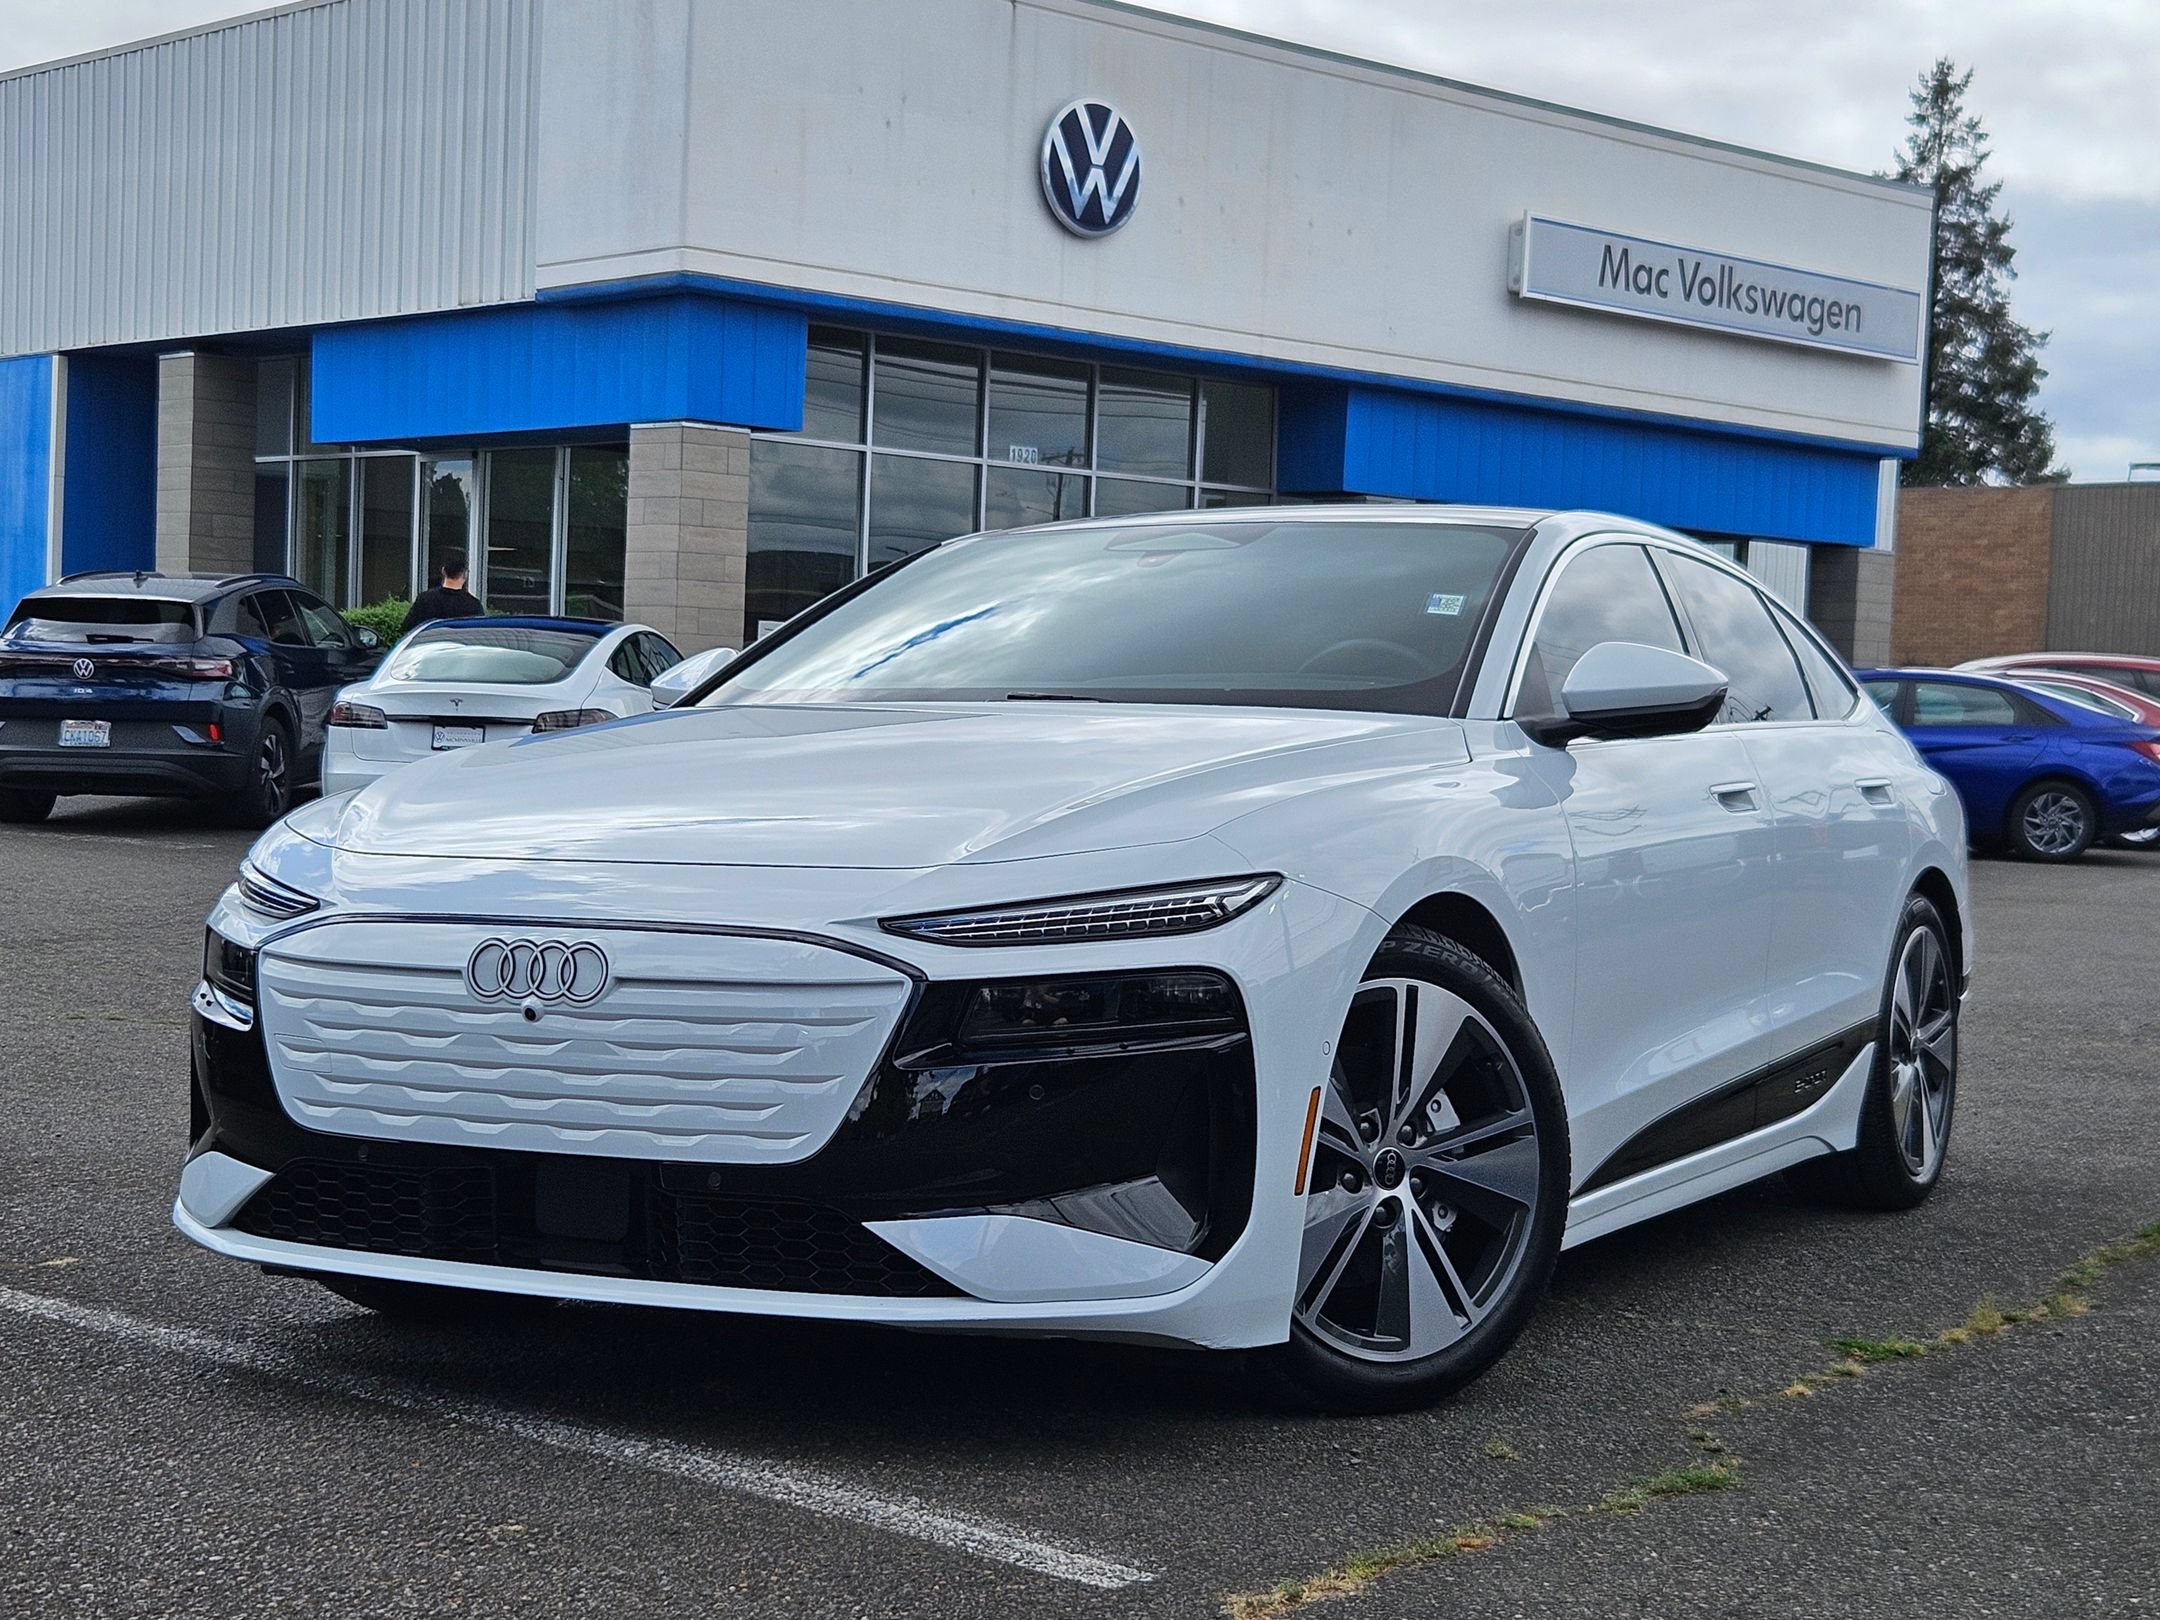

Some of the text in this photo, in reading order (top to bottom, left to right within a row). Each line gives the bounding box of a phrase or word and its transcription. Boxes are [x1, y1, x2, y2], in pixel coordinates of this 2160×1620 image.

[1042, 98, 1142, 237] VW
[1599, 244, 1862, 336] Mac Volkswagen
[1011, 447, 1037, 464] 1920
[73, 658, 94, 679] VW
[1379, 940, 1479, 974] P ZERO
